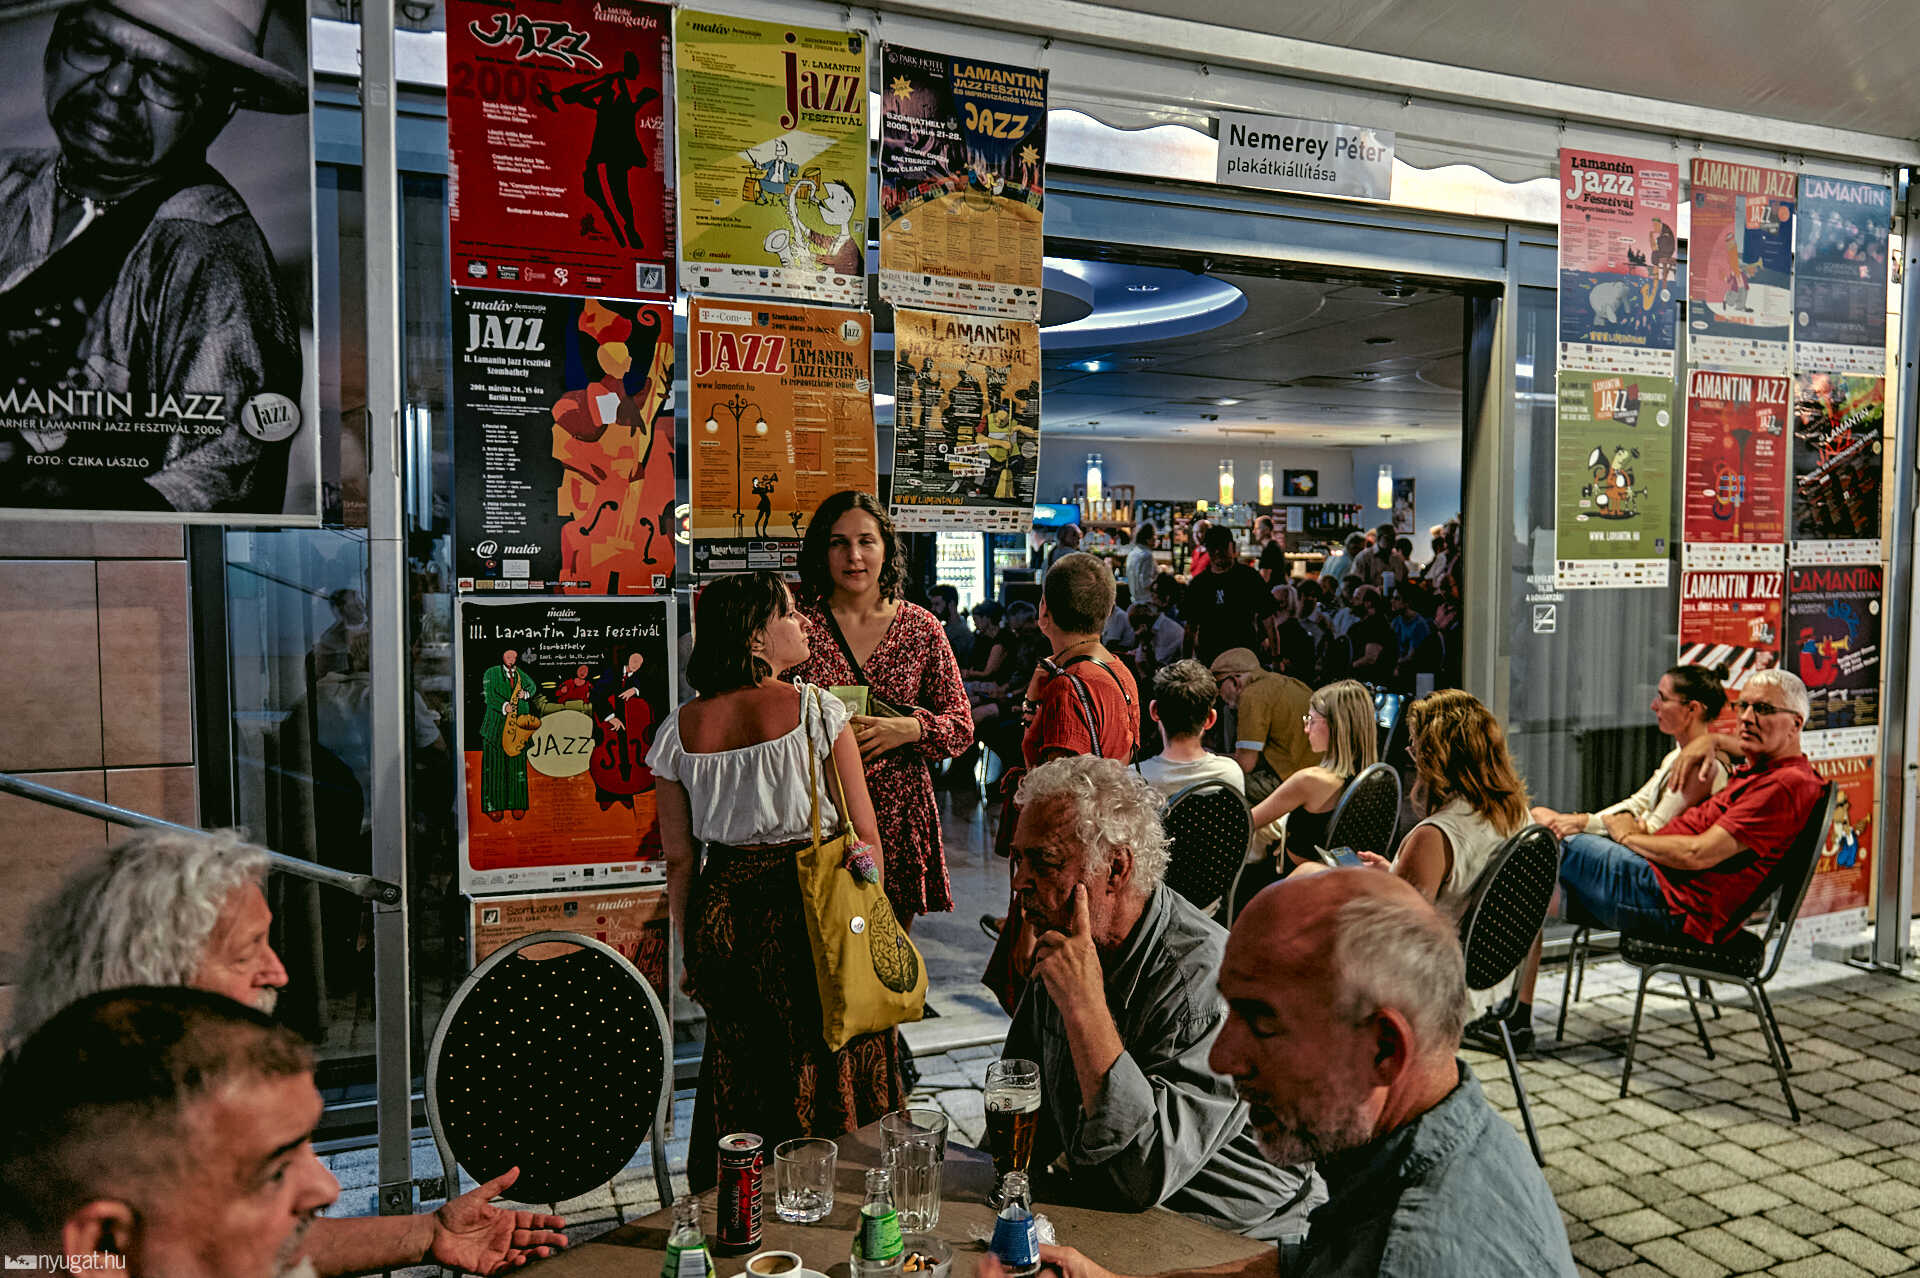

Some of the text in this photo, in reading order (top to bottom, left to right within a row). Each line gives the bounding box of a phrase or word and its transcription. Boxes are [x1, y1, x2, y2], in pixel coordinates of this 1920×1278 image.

[468, 12, 603, 69] JAZZ
[812, 60, 861, 73] LAMANTIN
[953, 63, 1043, 90] LAMANTIN
[780, 32, 861, 130] jazz
[953, 78, 1044, 101] JAZZ FESZTIVÁL
[801, 112, 863, 127] FESZTIVÁL
[886, 112, 945, 129] SZOMBATHELY
[964, 102, 1029, 139] JAZZ
[1230, 123, 1386, 162] Nemerey Péter
[1227, 157, 1336, 182] plakátkiállítása
[1571, 157, 1634, 174] Lamantin
[1565, 169, 1634, 200] Jazz
[1693, 160, 1760, 194] LAMANTIN
[1765, 171, 1794, 198] JAZZ
[1805, 178, 1884, 207] LAMANTIN
[472, 300, 513, 311] matáv
[465, 314, 546, 352] JAZZ
[473, 355, 506, 365] Lamantin
[507, 357, 522, 366] Jazz
[695, 330, 787, 376] JAZZ
[791, 348, 854, 367] LAMANTIN
[793, 365, 864, 380] JAZZ FESZTIVÁL
[697, 381, 756, 392] www.lamantin.hu
[1688, 372, 1787, 404] LAMANTIN JAZZ
[145, 392, 225, 420] JAZZ
[1600, 390, 1628, 411] JAZZ
[249, 396, 291, 435] jazz
[1825, 408, 1869, 443] LAMANTIN
[40, 420, 101, 431] LAMANTIN
[105, 422, 131, 432] JAZZ
[135, 421, 190, 434] FESZTIVÁL
[193, 424, 222, 435] 2006
[27, 455, 149, 468] FOTO: CZIKA LÁSZLÓ
[503, 543, 542, 554] matáv
[1683, 574, 1782, 599] LAMANTIN JAZZ
[1789, 567, 1882, 593] LAMANTIN
[469, 623, 660, 639] III. Lamantin Jazz Fesztivál
[539, 643, 586, 651] Szombathely
[531, 734, 594, 757] JAZZ
[1811, 757, 1865, 777] MANTIN
